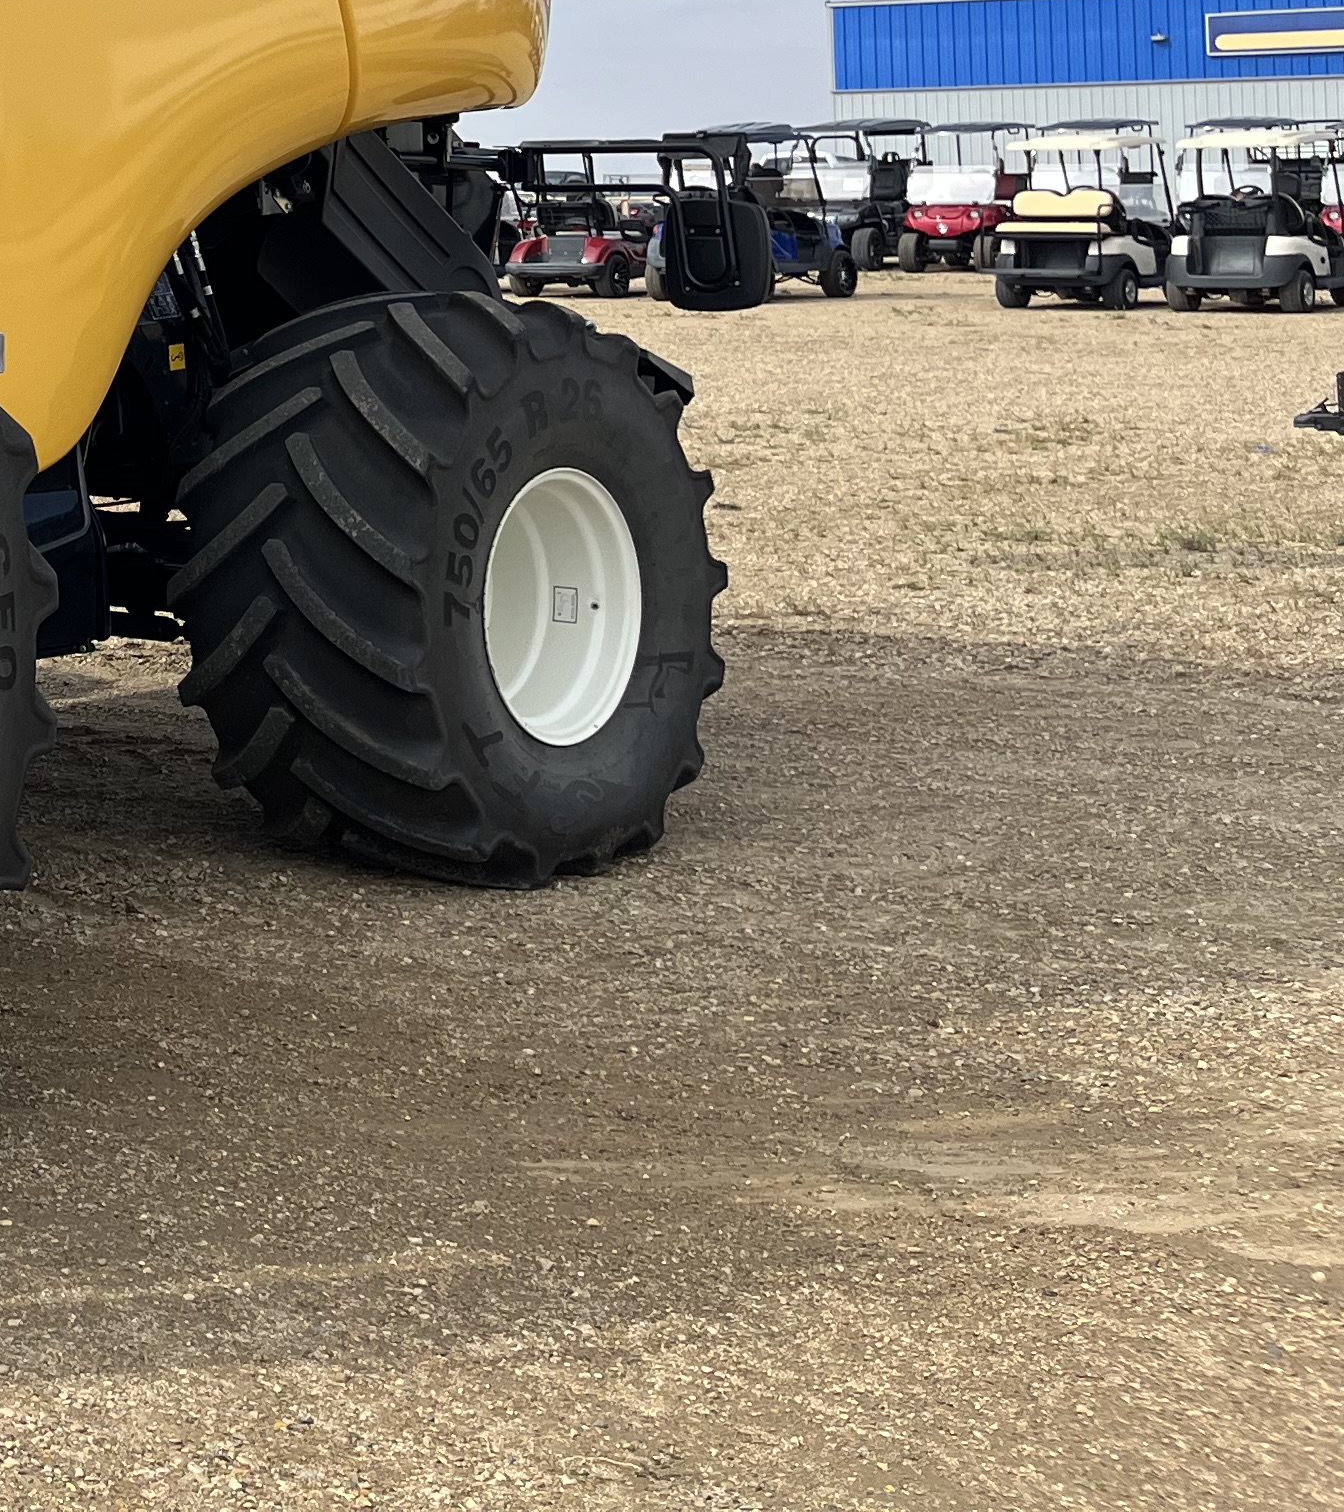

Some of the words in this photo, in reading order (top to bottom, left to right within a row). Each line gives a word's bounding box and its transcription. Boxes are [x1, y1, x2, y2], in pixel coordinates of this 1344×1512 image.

[444, 425, 513, 628] 750/65
[520, 390, 549, 440] R
[562, 377, 603, 423] 26
